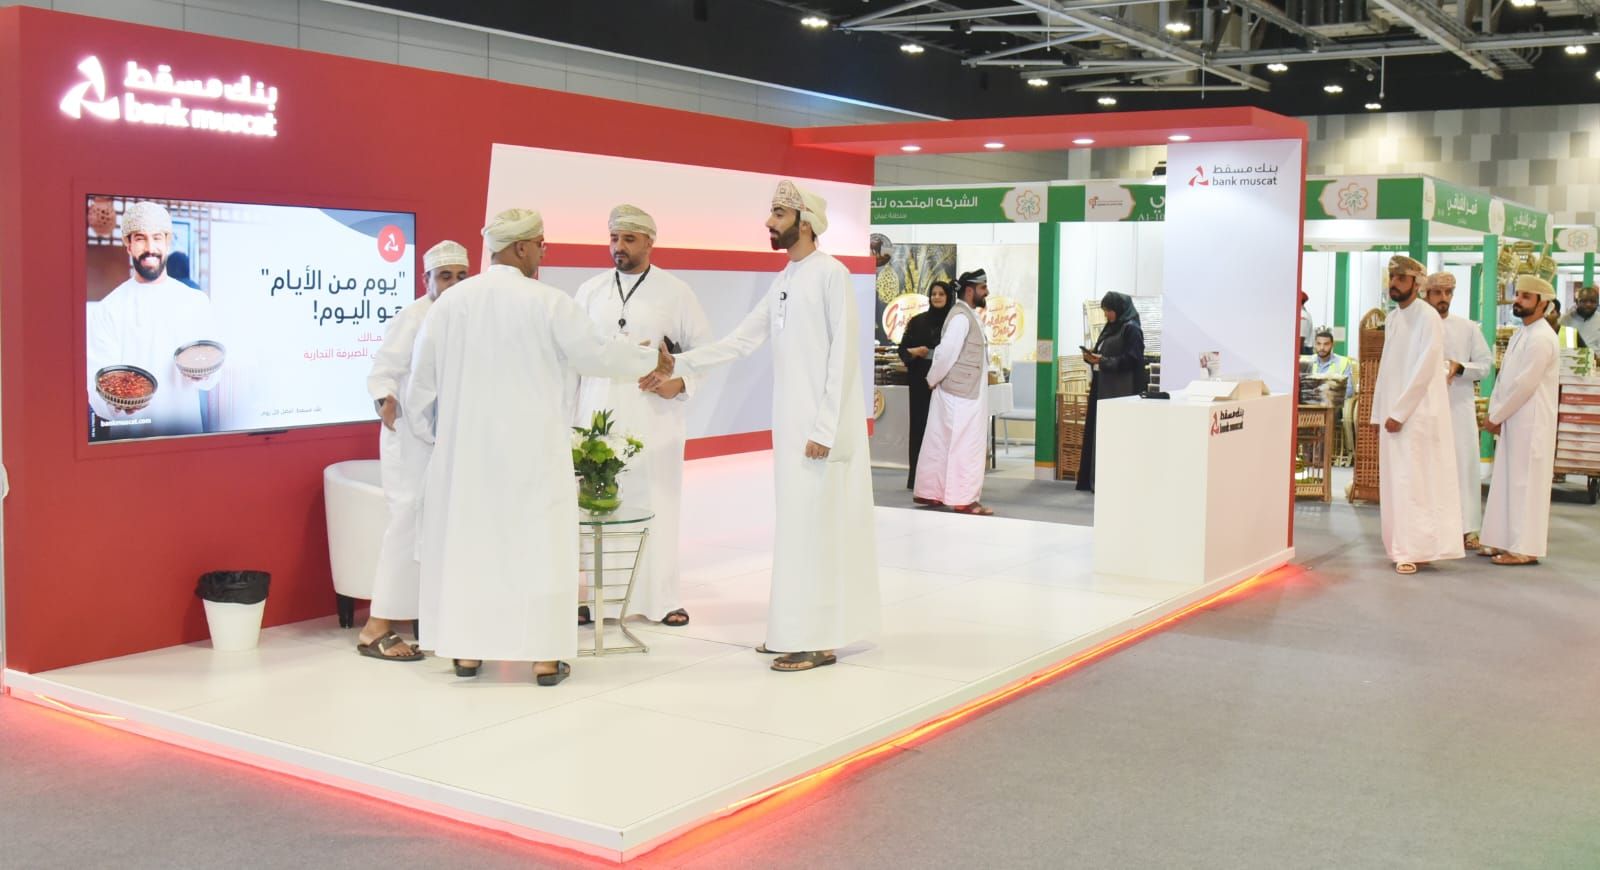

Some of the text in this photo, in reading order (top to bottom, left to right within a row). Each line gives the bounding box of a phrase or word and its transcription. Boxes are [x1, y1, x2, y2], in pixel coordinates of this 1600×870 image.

[123, 60, 278, 111] بنك مسقط
[124, 92, 277, 137] bank muscat
[1212, 162, 1279, 176] بنك مسقط
[1212, 176, 1278, 186] bank muscat
[261, 265, 405, 297] "يوم من الأيام"
[313, 300, 370, 326] اليوم!
[100, 418, 152, 427] bankmuscat.com
